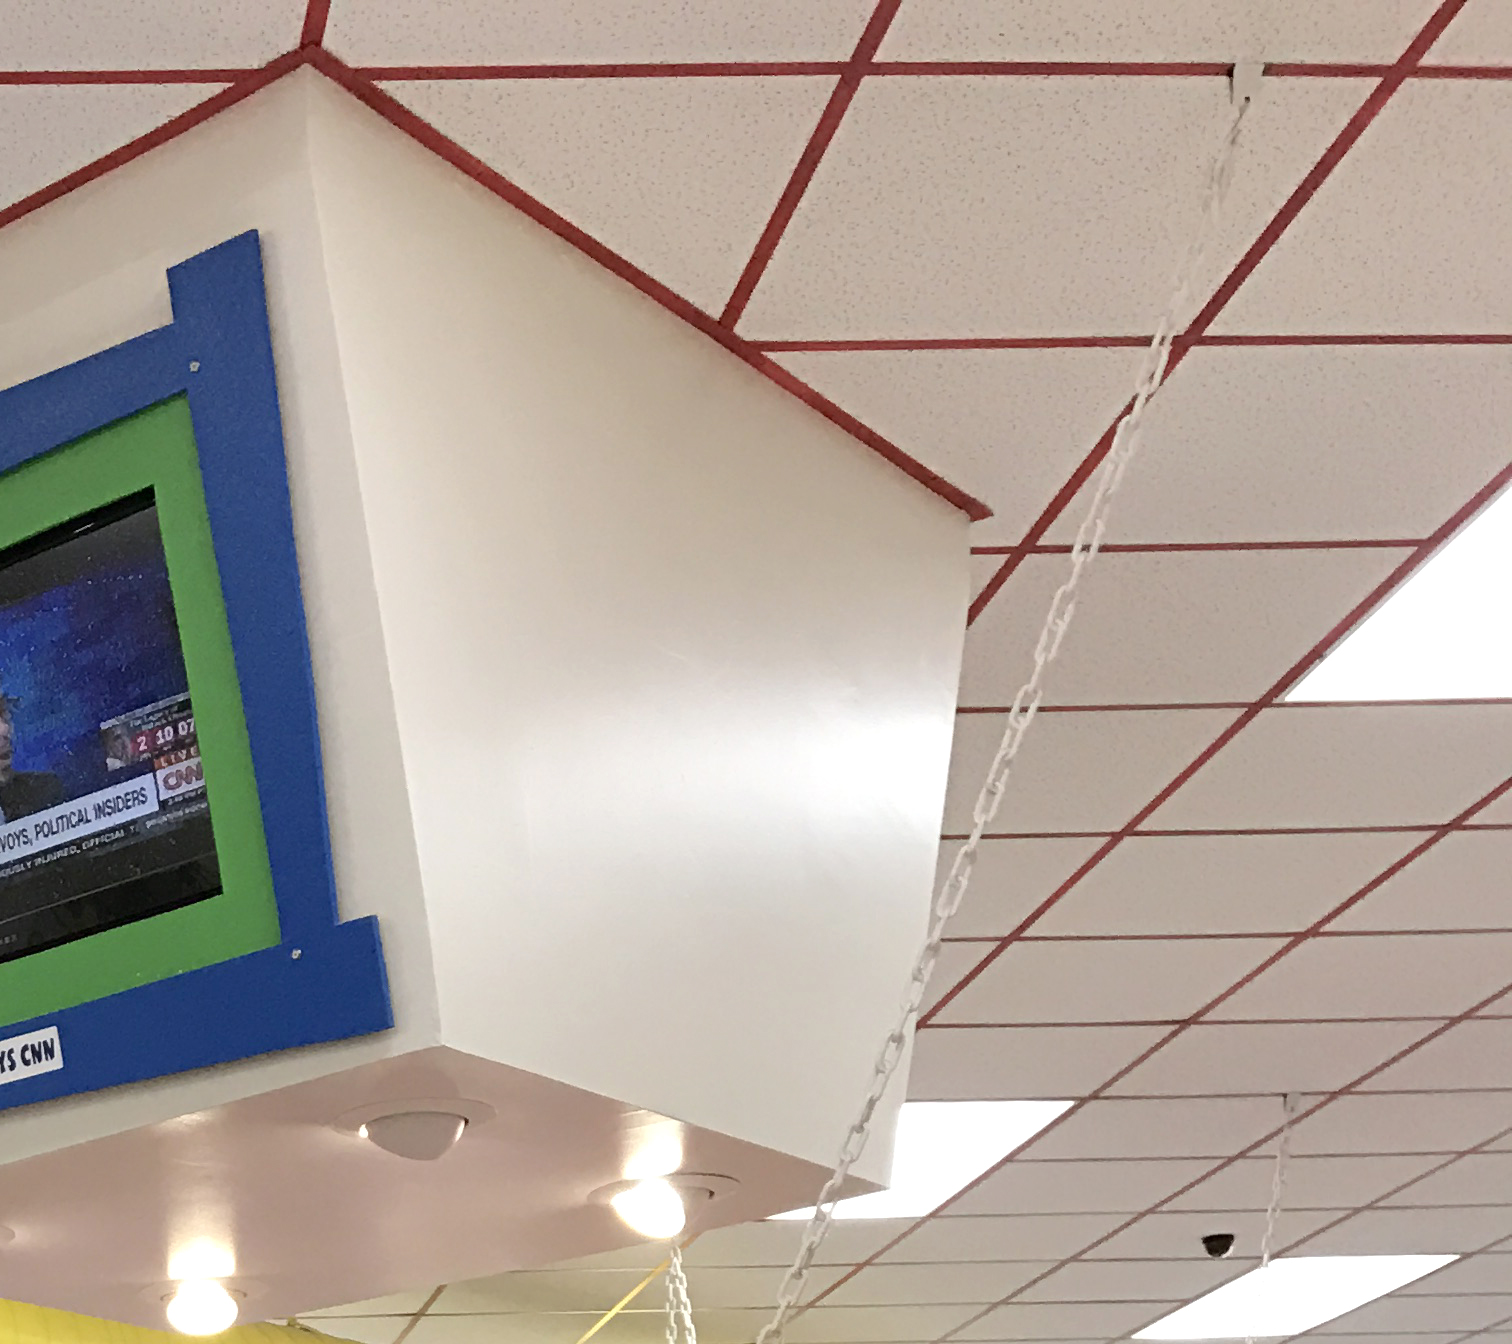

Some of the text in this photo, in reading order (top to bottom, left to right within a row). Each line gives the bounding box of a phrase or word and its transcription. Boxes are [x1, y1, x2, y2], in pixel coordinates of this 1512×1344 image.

[161, 745, 198, 768] LIVE
[34, 806, 92, 841] POLITICAL
[93, 786, 149, 821] INSIDERS
[20, 1037, 56, 1067] CNN
